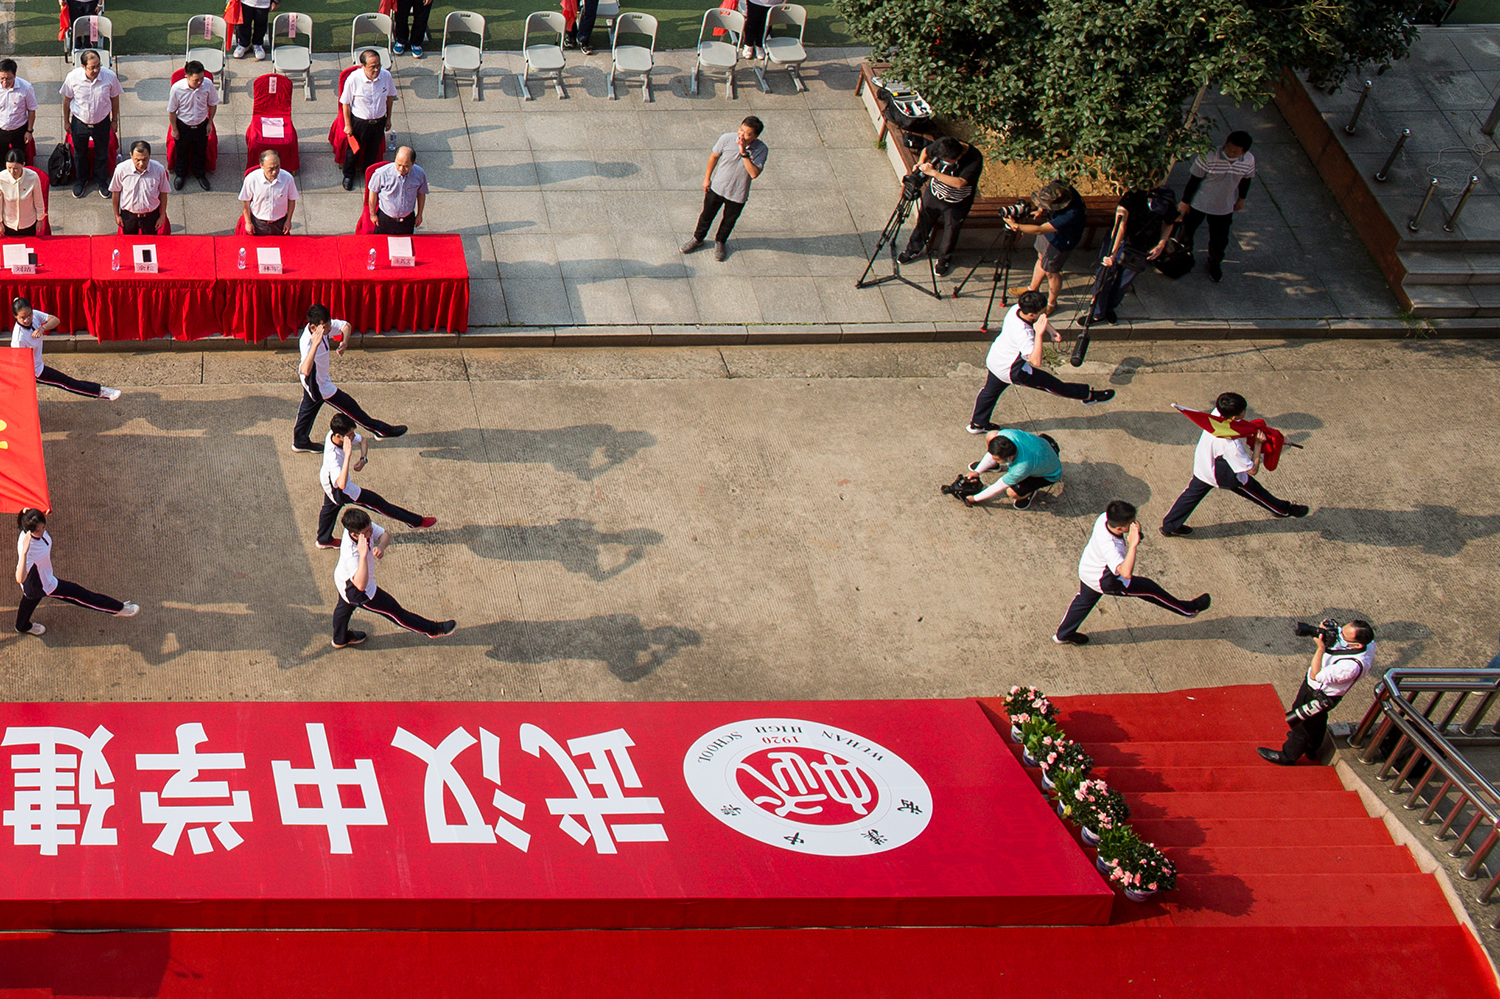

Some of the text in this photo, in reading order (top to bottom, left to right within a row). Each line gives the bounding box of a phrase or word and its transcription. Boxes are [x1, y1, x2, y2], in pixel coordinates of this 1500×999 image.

[697, 725, 884, 765] WUHAN HIGH SCHOOL
[762, 735, 800, 744] 1920
